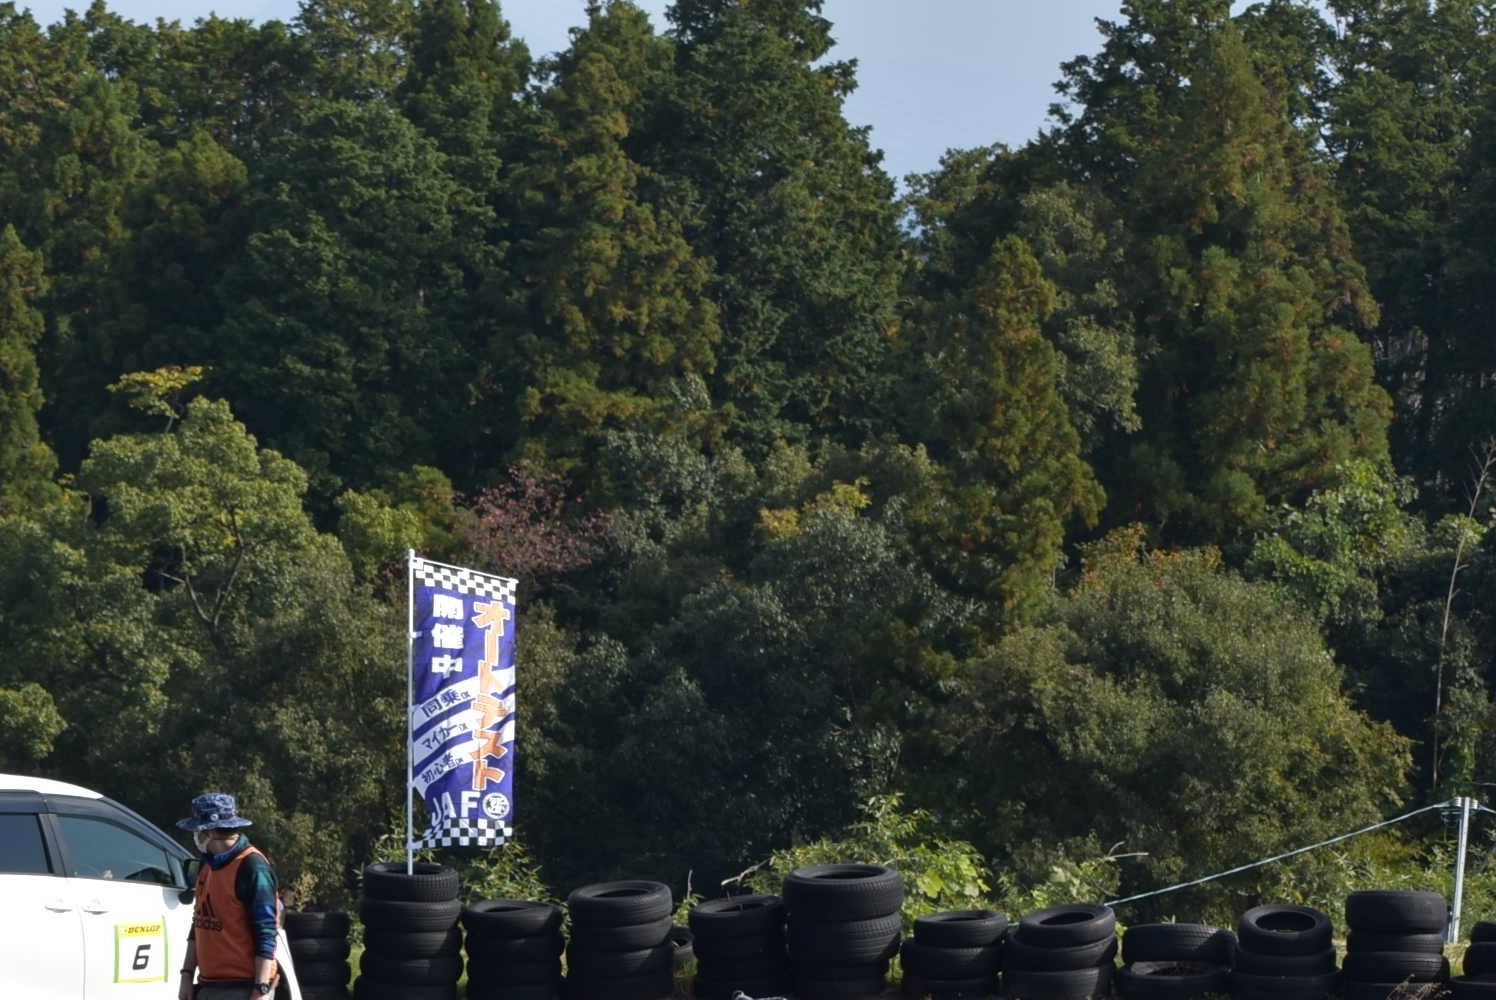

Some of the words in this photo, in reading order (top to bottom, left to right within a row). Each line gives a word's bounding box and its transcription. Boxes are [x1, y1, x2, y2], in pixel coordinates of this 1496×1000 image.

[431, 593, 464, 679] 開催中
[470, 600, 511, 791] オートテスト
[431, 791, 481, 827] JAF
[127, 924, 161, 935] DUNLOP
[132, 943, 152, 971] 6
